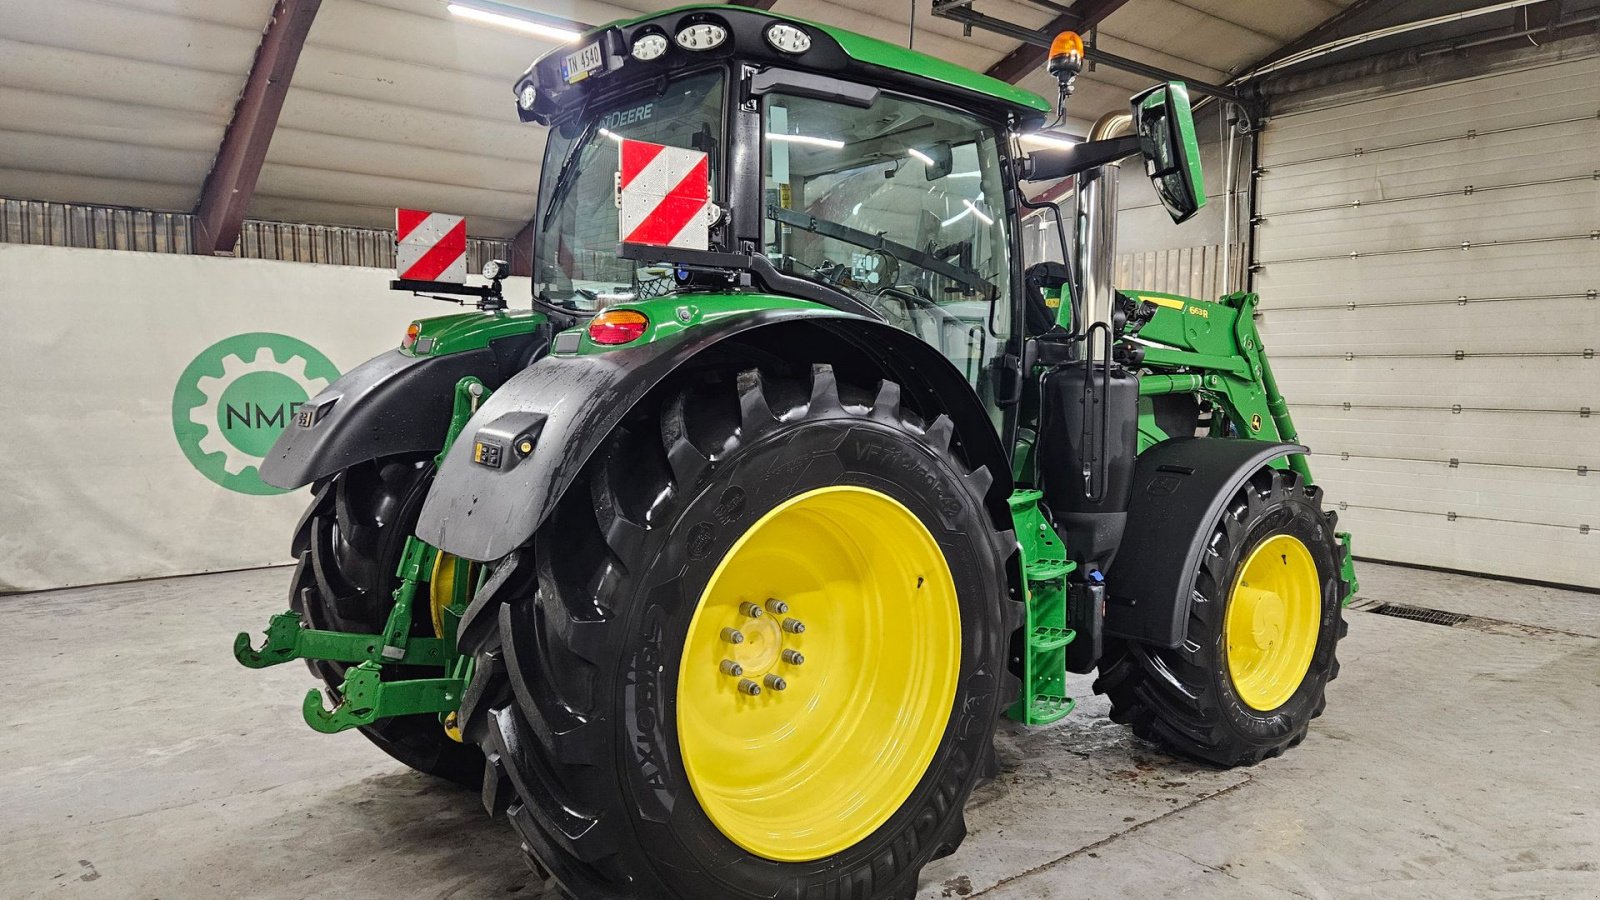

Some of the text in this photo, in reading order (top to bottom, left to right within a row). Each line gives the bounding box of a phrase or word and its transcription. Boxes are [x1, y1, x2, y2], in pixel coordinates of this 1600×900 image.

[581, 46, 599, 68] 4540
[611, 104, 653, 129] DEERE
[1190, 306, 1208, 318] 663R
